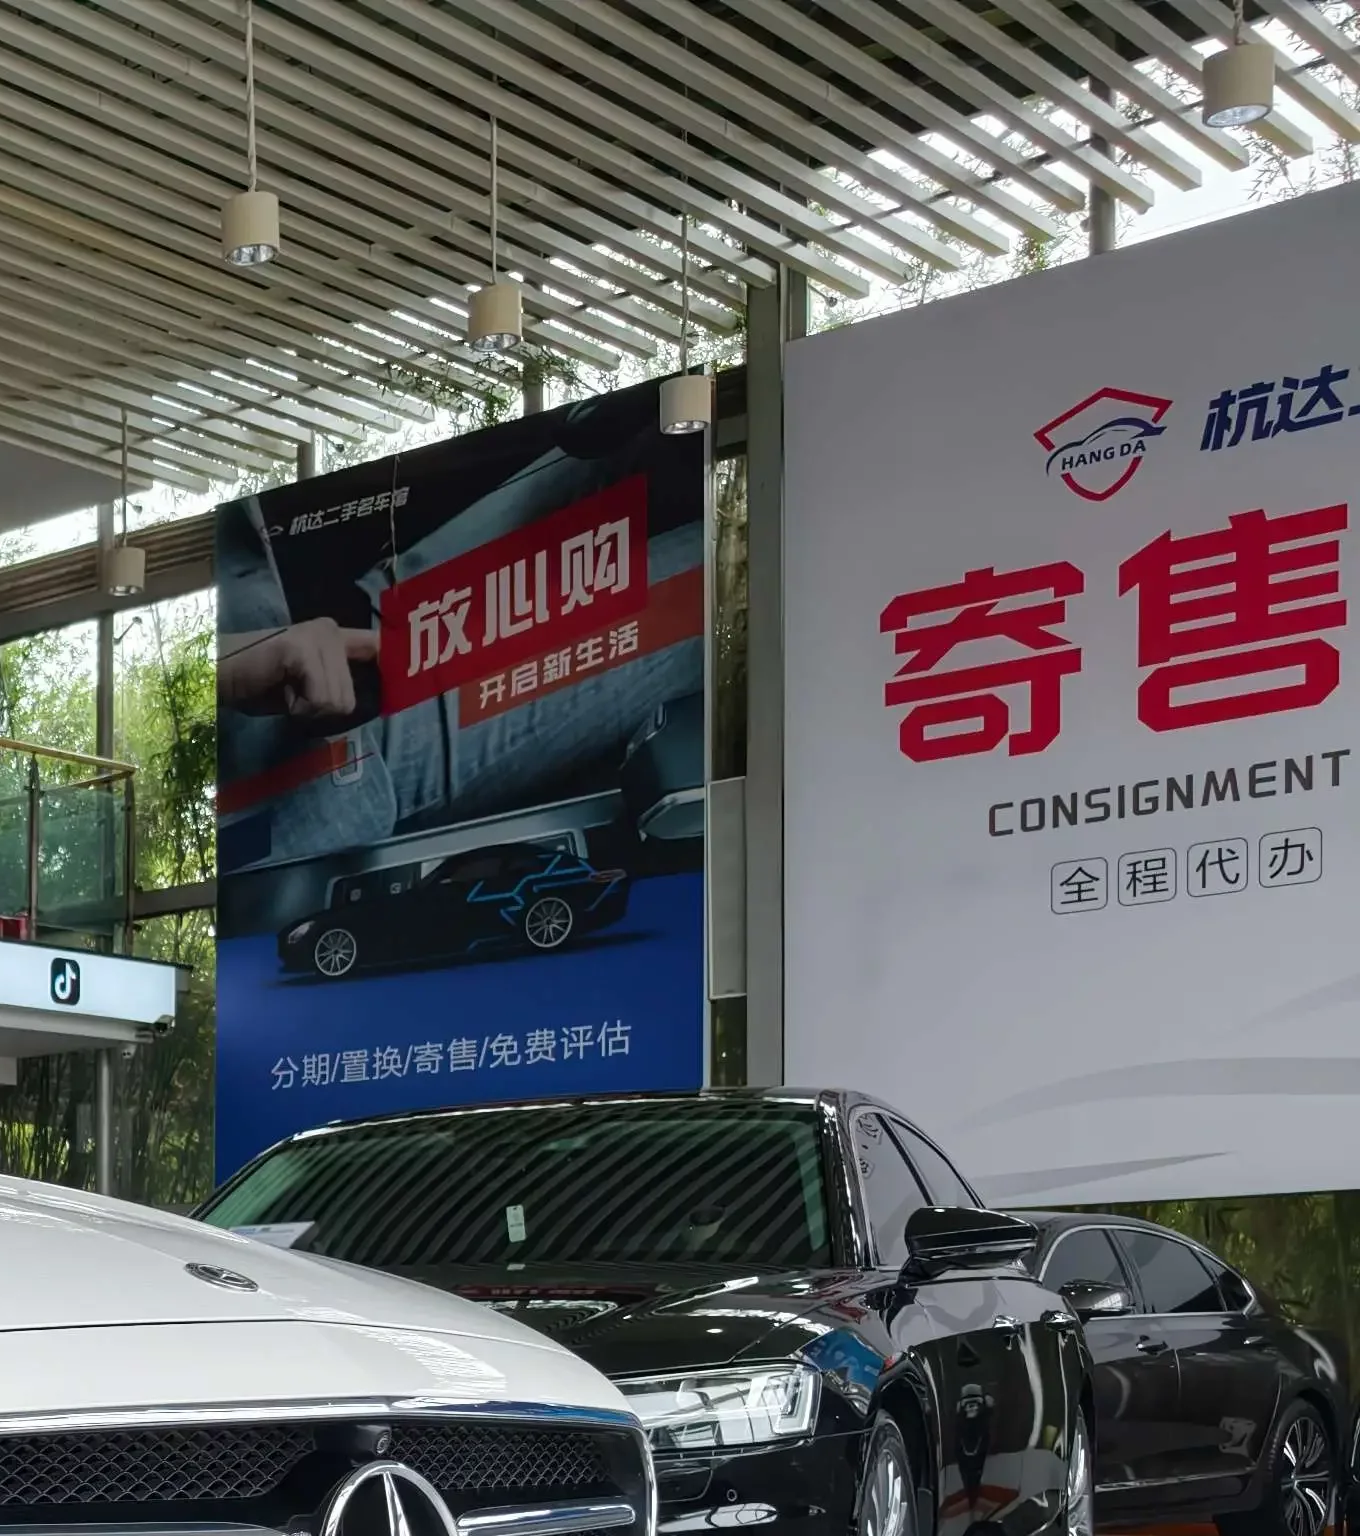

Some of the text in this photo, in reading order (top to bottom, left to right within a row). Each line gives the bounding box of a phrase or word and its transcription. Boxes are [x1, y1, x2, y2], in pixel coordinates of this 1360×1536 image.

[1200, 364, 1360, 451] 杭达
[1061, 440, 1146, 470] HANG DA
[289, 486, 410, 536] 杭达二手名车馆
[407, 516, 630, 678] 放心购
[880, 503, 1348, 763] 寄售
[479, 620, 639, 709] 开启新生活
[988, 749, 1351, 837] CONSIGNMENT
[1060, 837, 1314, 905] 全程代办
[270, 1019, 632, 1091] 分期/置换/寄售/免费评估
